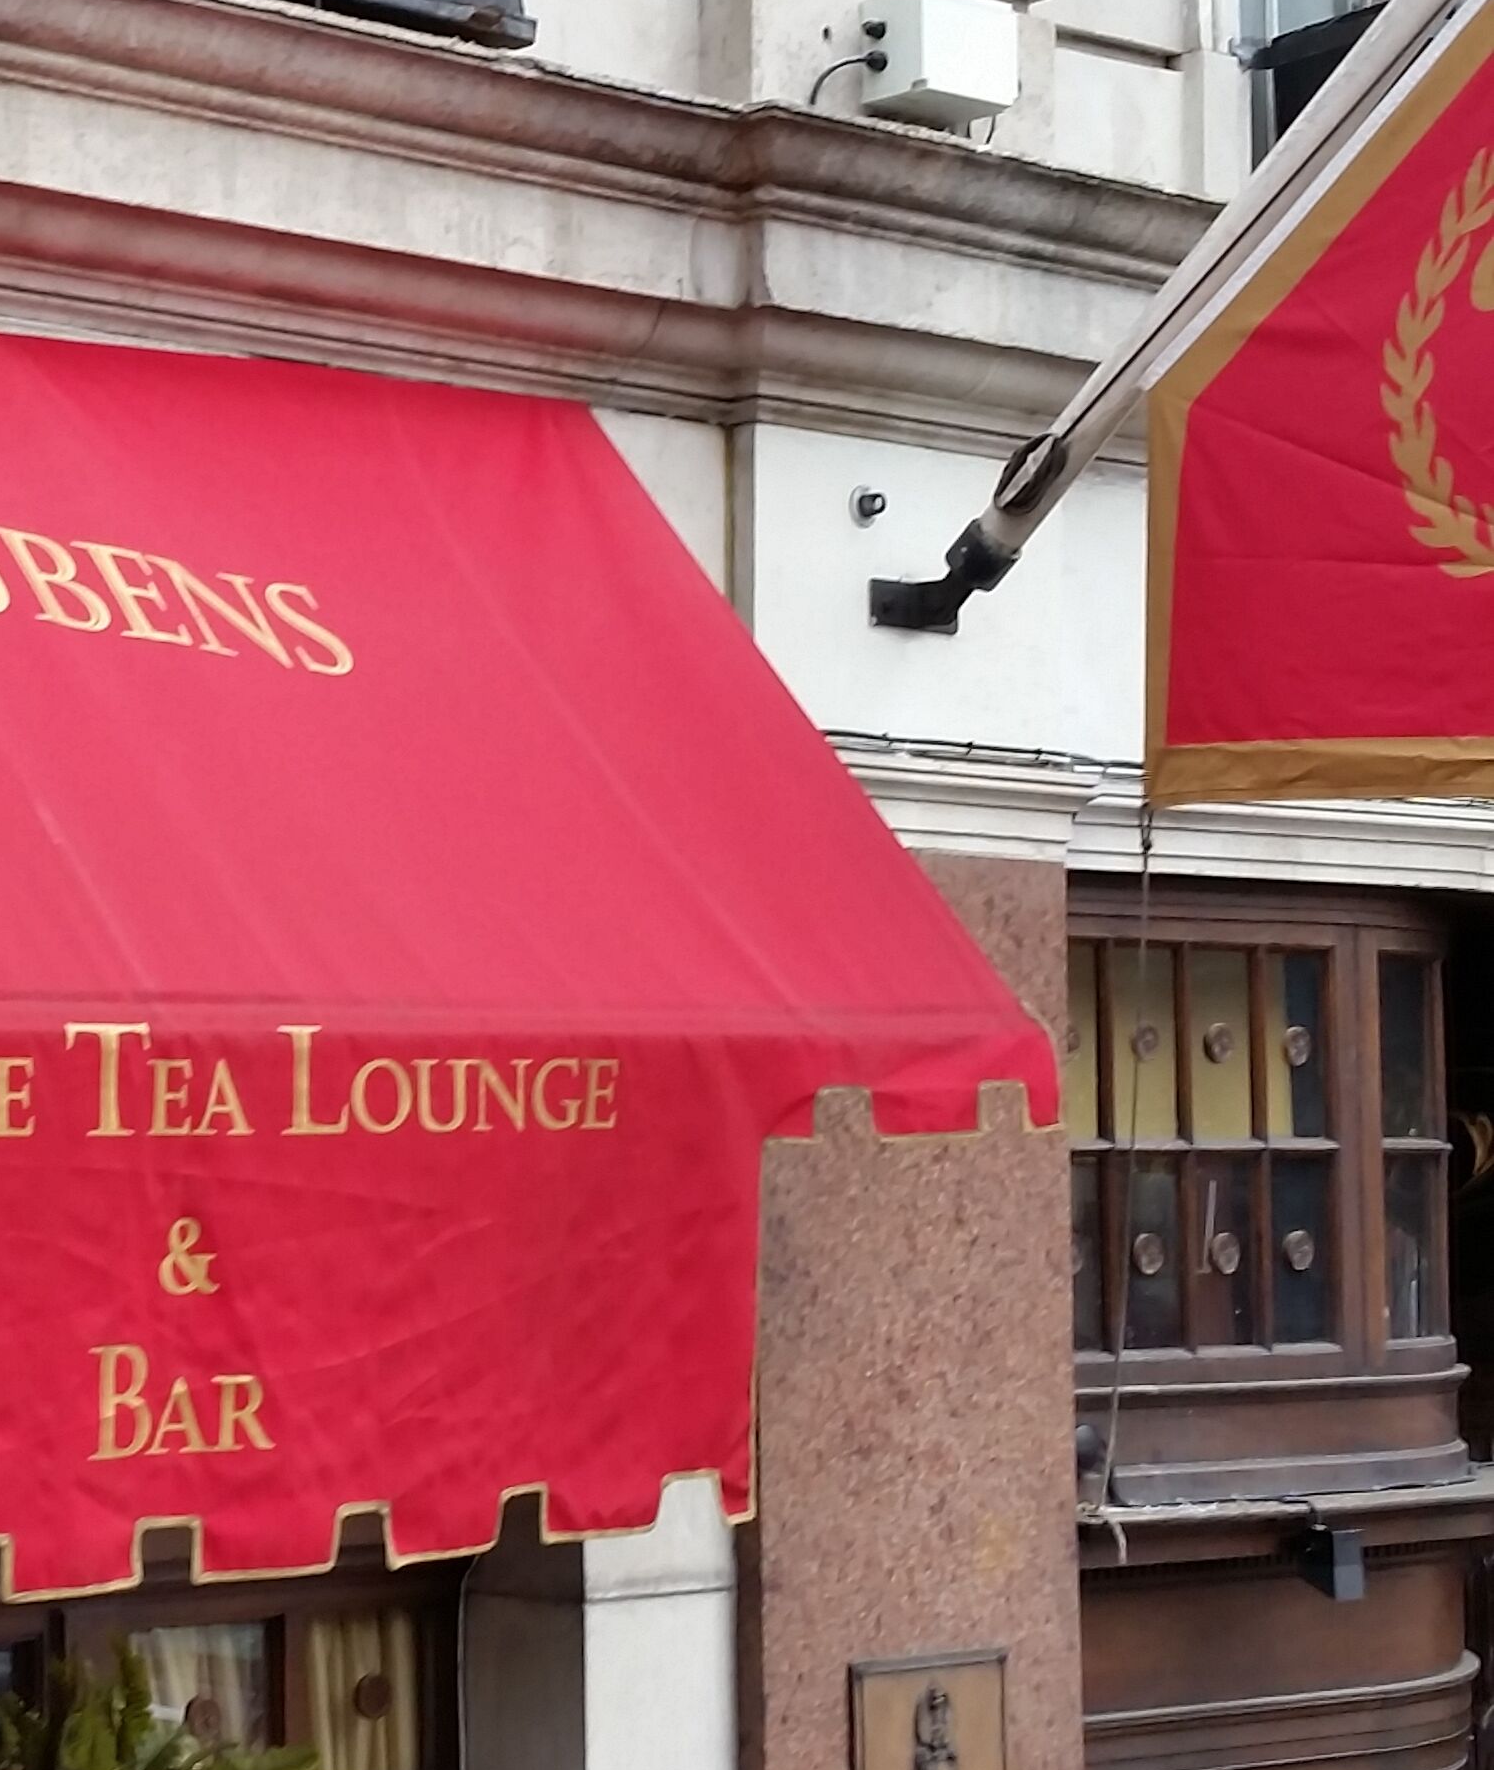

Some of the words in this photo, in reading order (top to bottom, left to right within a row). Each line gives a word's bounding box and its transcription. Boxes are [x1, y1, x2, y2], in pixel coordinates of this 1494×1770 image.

[64, 1021, 254, 1137] TEA
[277, 1024, 619, 1136] LOUNGE
[158, 1216, 219, 1295] &
[88, 1343, 276, 1460] BAR
